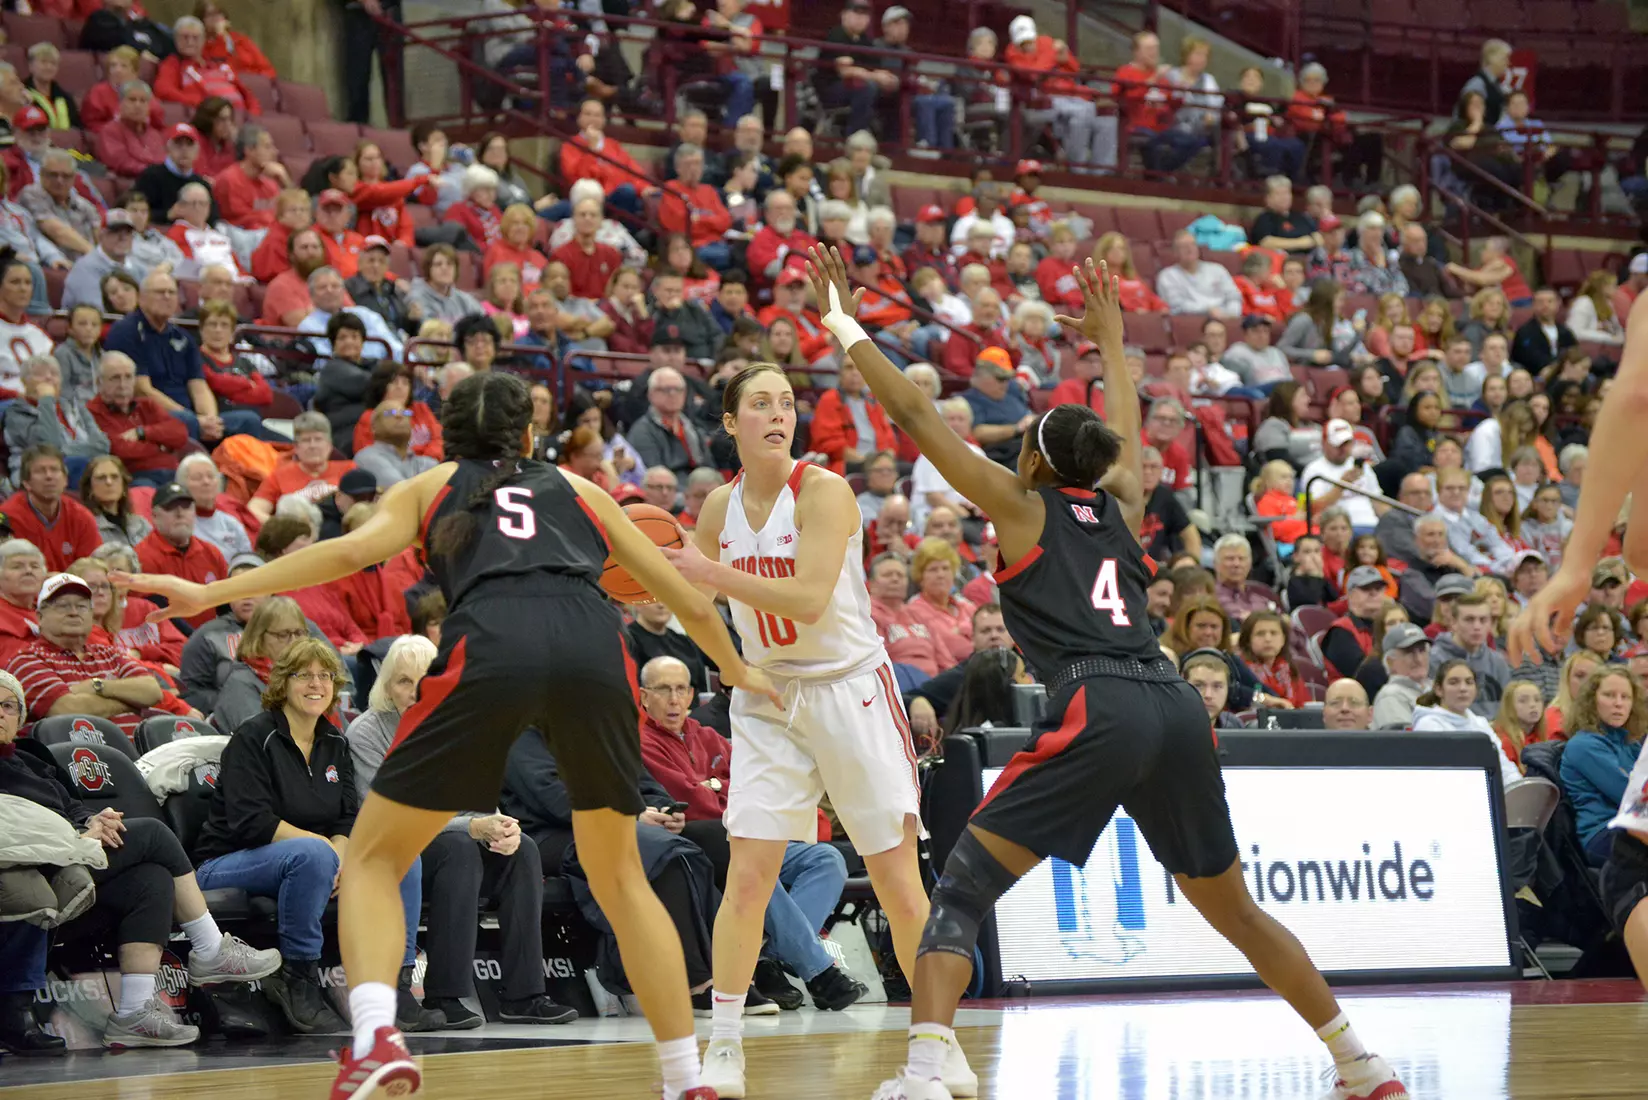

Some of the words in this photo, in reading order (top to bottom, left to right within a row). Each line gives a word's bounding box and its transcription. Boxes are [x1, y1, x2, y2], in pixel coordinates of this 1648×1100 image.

[494, 486, 537, 540] 5
[1070, 503, 1100, 523] N
[1090, 557, 1132, 626] 4
[753, 608, 798, 649] 10
[473, 959, 501, 980] GO
[542, 957, 577, 979] KS!
[33, 979, 108, 1004] UCKS!
